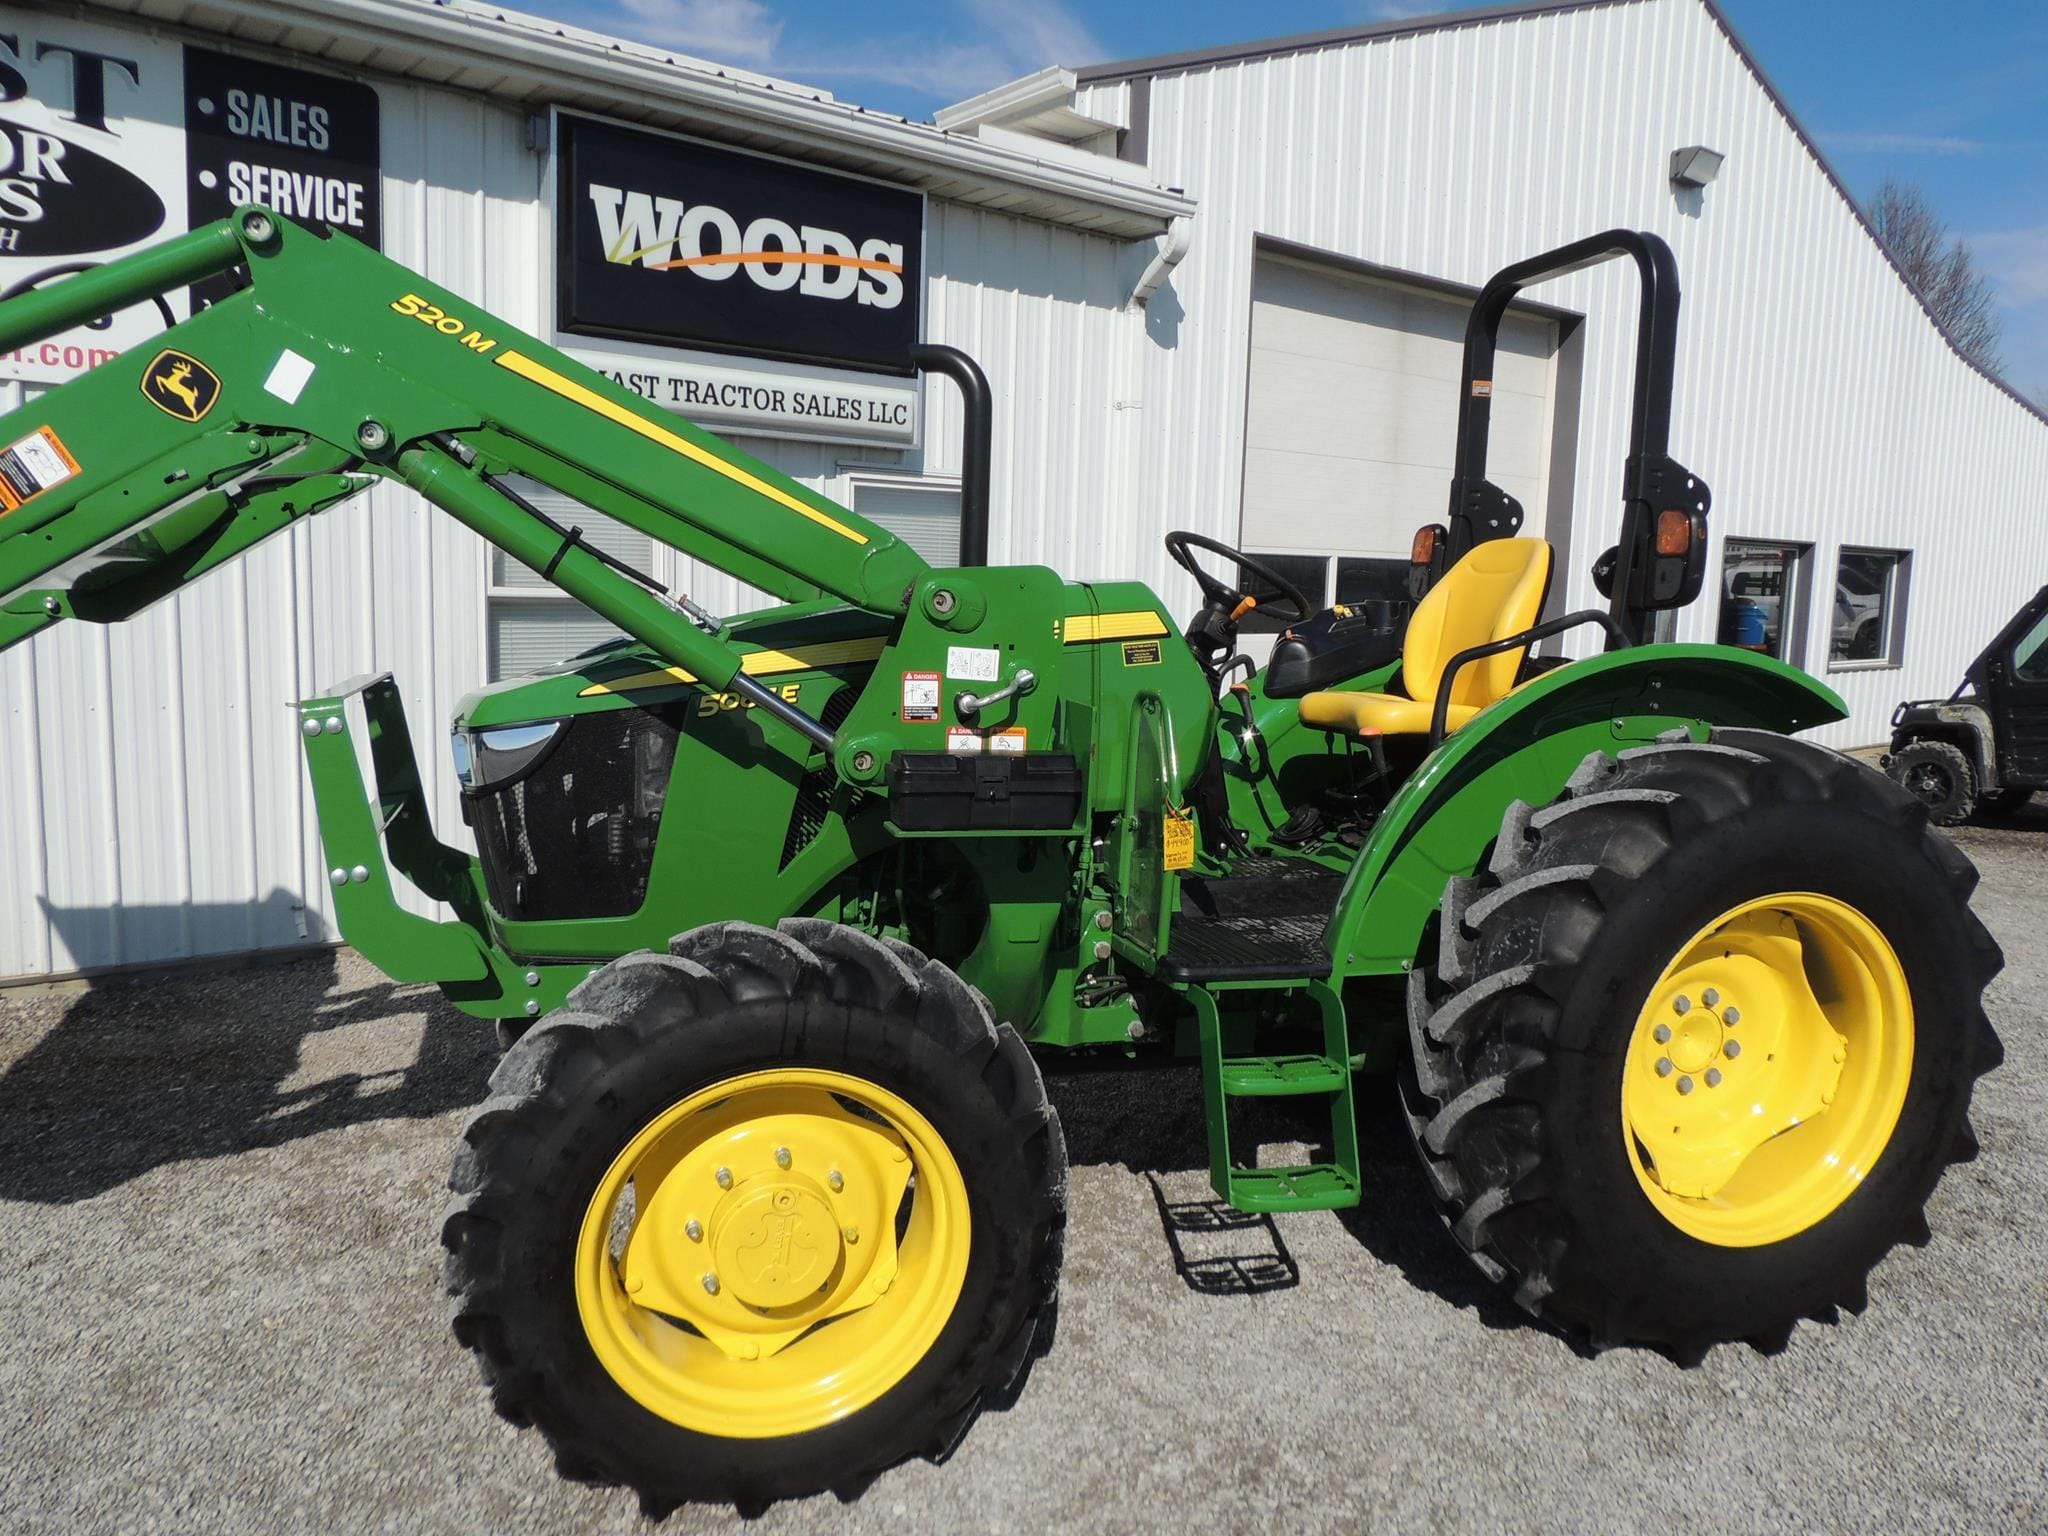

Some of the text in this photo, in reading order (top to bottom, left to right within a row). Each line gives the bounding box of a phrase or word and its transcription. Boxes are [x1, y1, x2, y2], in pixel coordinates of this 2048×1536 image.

[227, 88, 329, 151] SALES
[228, 161, 364, 227] SERVICE
[589, 183, 904, 309] WOODS
[599, 370, 907, 425] AST TRACTOR SALES LLC
